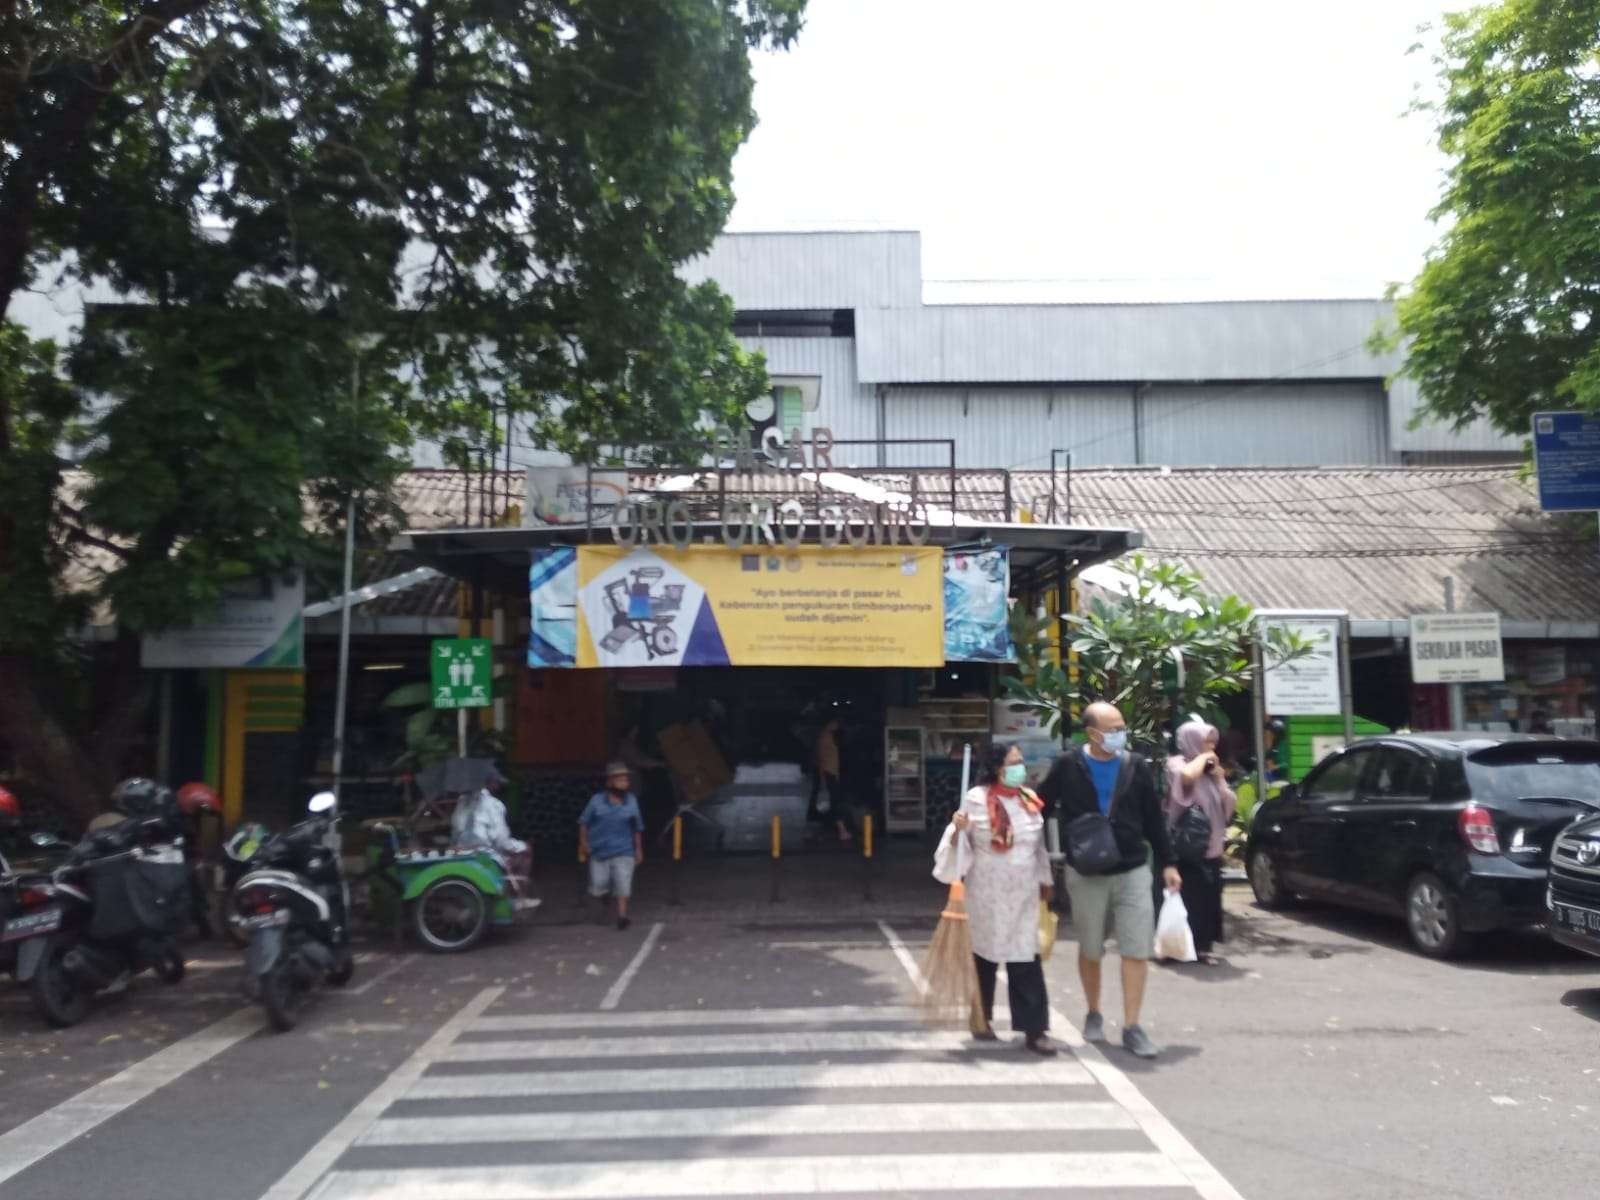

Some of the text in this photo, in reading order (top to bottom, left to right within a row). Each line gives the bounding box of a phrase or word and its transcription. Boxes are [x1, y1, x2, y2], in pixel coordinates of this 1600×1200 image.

[714, 427, 835, 475] PASAR
[853, 590, 884, 600] pasar
[1416, 640, 1498, 660] SEKOLAH PASAR
